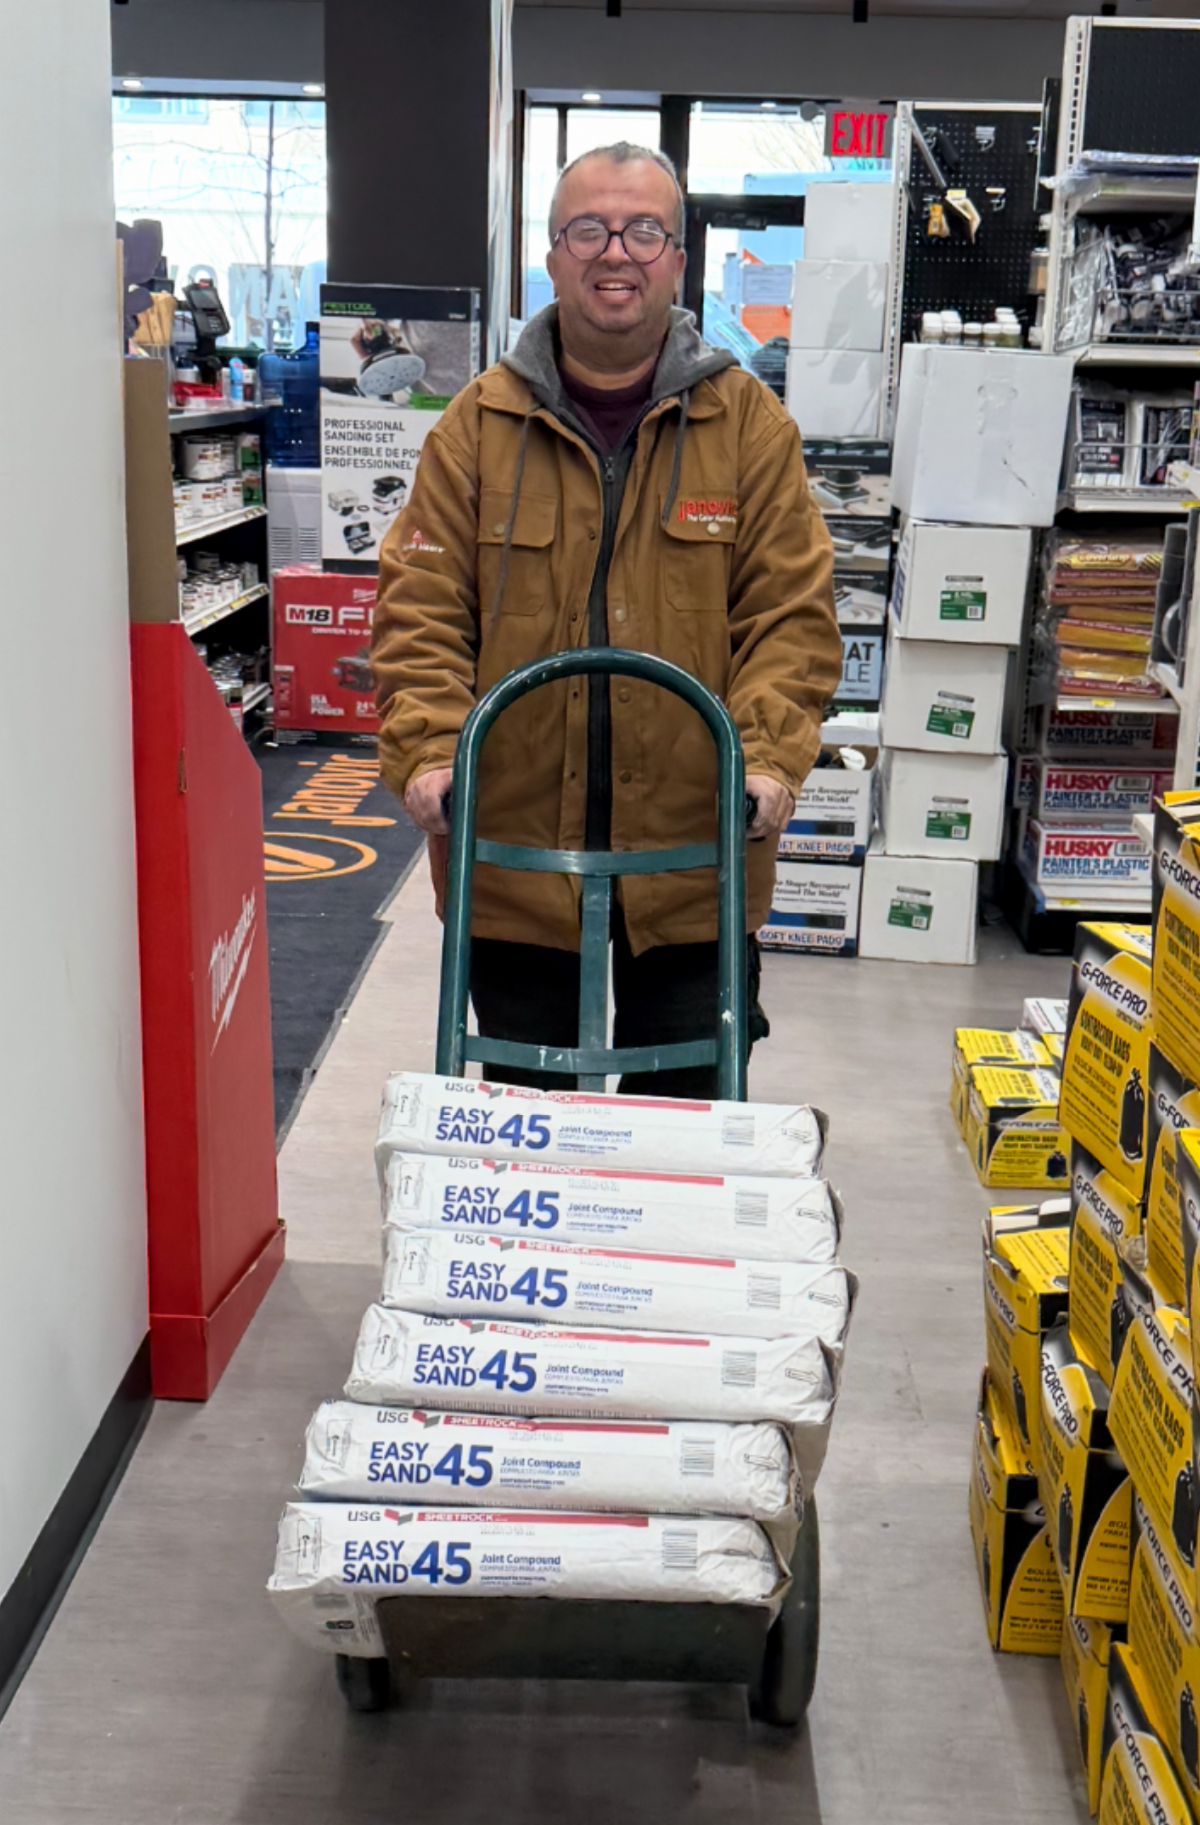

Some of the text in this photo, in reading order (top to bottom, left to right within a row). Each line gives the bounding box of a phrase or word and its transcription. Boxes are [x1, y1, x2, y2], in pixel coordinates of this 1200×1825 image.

[831, 111, 888, 157] EXIT
[324, 418, 405, 431] PROFESSIONAL
[324, 430, 395, 443] SANDING SET
[324, 445, 421, 459] ENSEMBLE DE PON
[324, 458, 412, 470] PROFESSIONNEL
[289, 607, 330, 622] M18
[841, 641, 875, 661] AT
[1047, 727, 1153, 741] PAINTER'S PLASTIC
[1045, 773, 1114, 791] HUSKY
[1043, 791, 1149, 805] PAINTER'S PLASTIC
[796, 841, 822, 852] KNEE
[825, 841, 851, 853] PADS
[1044, 840, 1113, 857] HUSKY
[1041, 857, 1150, 871] PAINTER'S PLASTIC
[788, 931, 812, 943] KNEE
[816, 933, 843, 945] PADS
[1080, 961, 1148, 1016] G-FORCE PRO
[445, 1082, 475, 1093] USG
[439, 1106, 494, 1125] EASY
[435, 1123, 495, 1145] SAND
[497, 1114, 551, 1149] 45
[558, 1126, 632, 1138] Joint Compound
[448, 1157, 479, 1169] USG
[444, 1186, 500, 1204] EASY
[441, 1189, 560, 1229] SAND 45
[568, 1203, 643, 1216] Joint Compound
[1103, 1206, 1124, 1236] PRO
[454, 1233, 486, 1246] USG
[449, 1260, 506, 1281] EASY
[446, 1280, 508, 1302] SAND
[510, 1267, 568, 1308] 45
[576, 1282, 653, 1296] Joint Compound
[416, 1344, 475, 1365] EASY
[413, 1349, 537, 1392] SAND 45
[545, 1364, 624, 1377] Joint Compound
[1172, 1362, 1195, 1398] PR
[376, 1410, 409, 1424] USG
[450, 1416, 516, 1429] SHEETROCK
[1058, 1401, 1078, 1434] PRO
[370, 1441, 429, 1461] EASY
[367, 1444, 493, 1487] SAND 45
[501, 1457, 581, 1469] Joint Compound
[347, 1511, 381, 1522] USG
[424, 1513, 494, 1522] SHEETROCK
[344, 1541, 405, 1561] EASY
[342, 1541, 471, 1585] SAND 45
[480, 1554, 561, 1565] Joint Compound
[1137, 1496, 1171, 1583] G-FORCE
[1168, 1580, 1193, 1628] PRO
[1074, 1618, 1089, 1644] RO
[1113, 1702, 1152, 1793] G-FORCE
